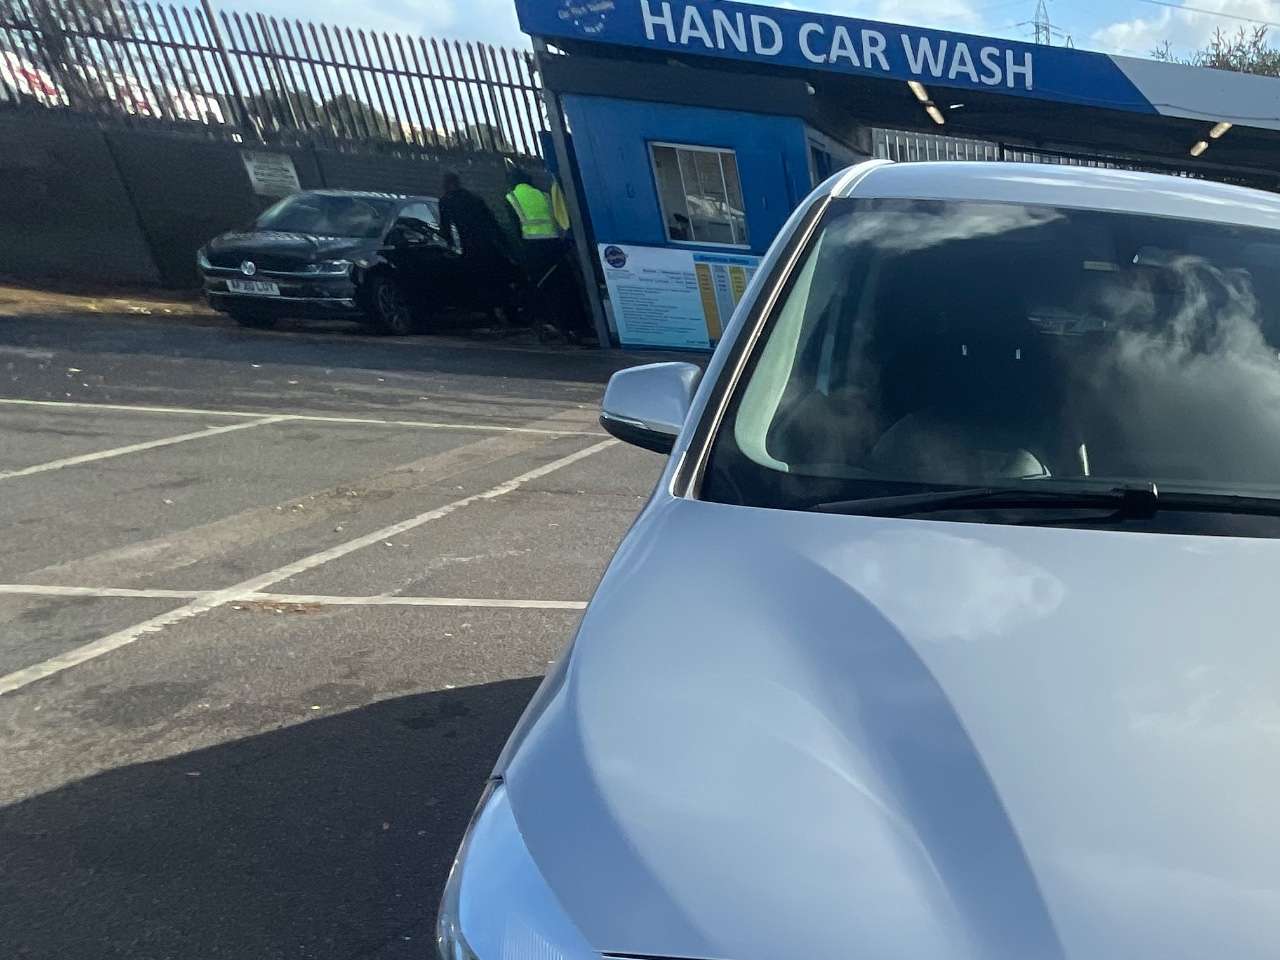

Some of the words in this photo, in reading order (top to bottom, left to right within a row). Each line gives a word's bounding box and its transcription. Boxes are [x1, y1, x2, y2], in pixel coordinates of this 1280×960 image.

[640, 0, 784, 56] HAND
[798, 22, 890, 72] CAR
[900, 33, 1034, 91] WASH
